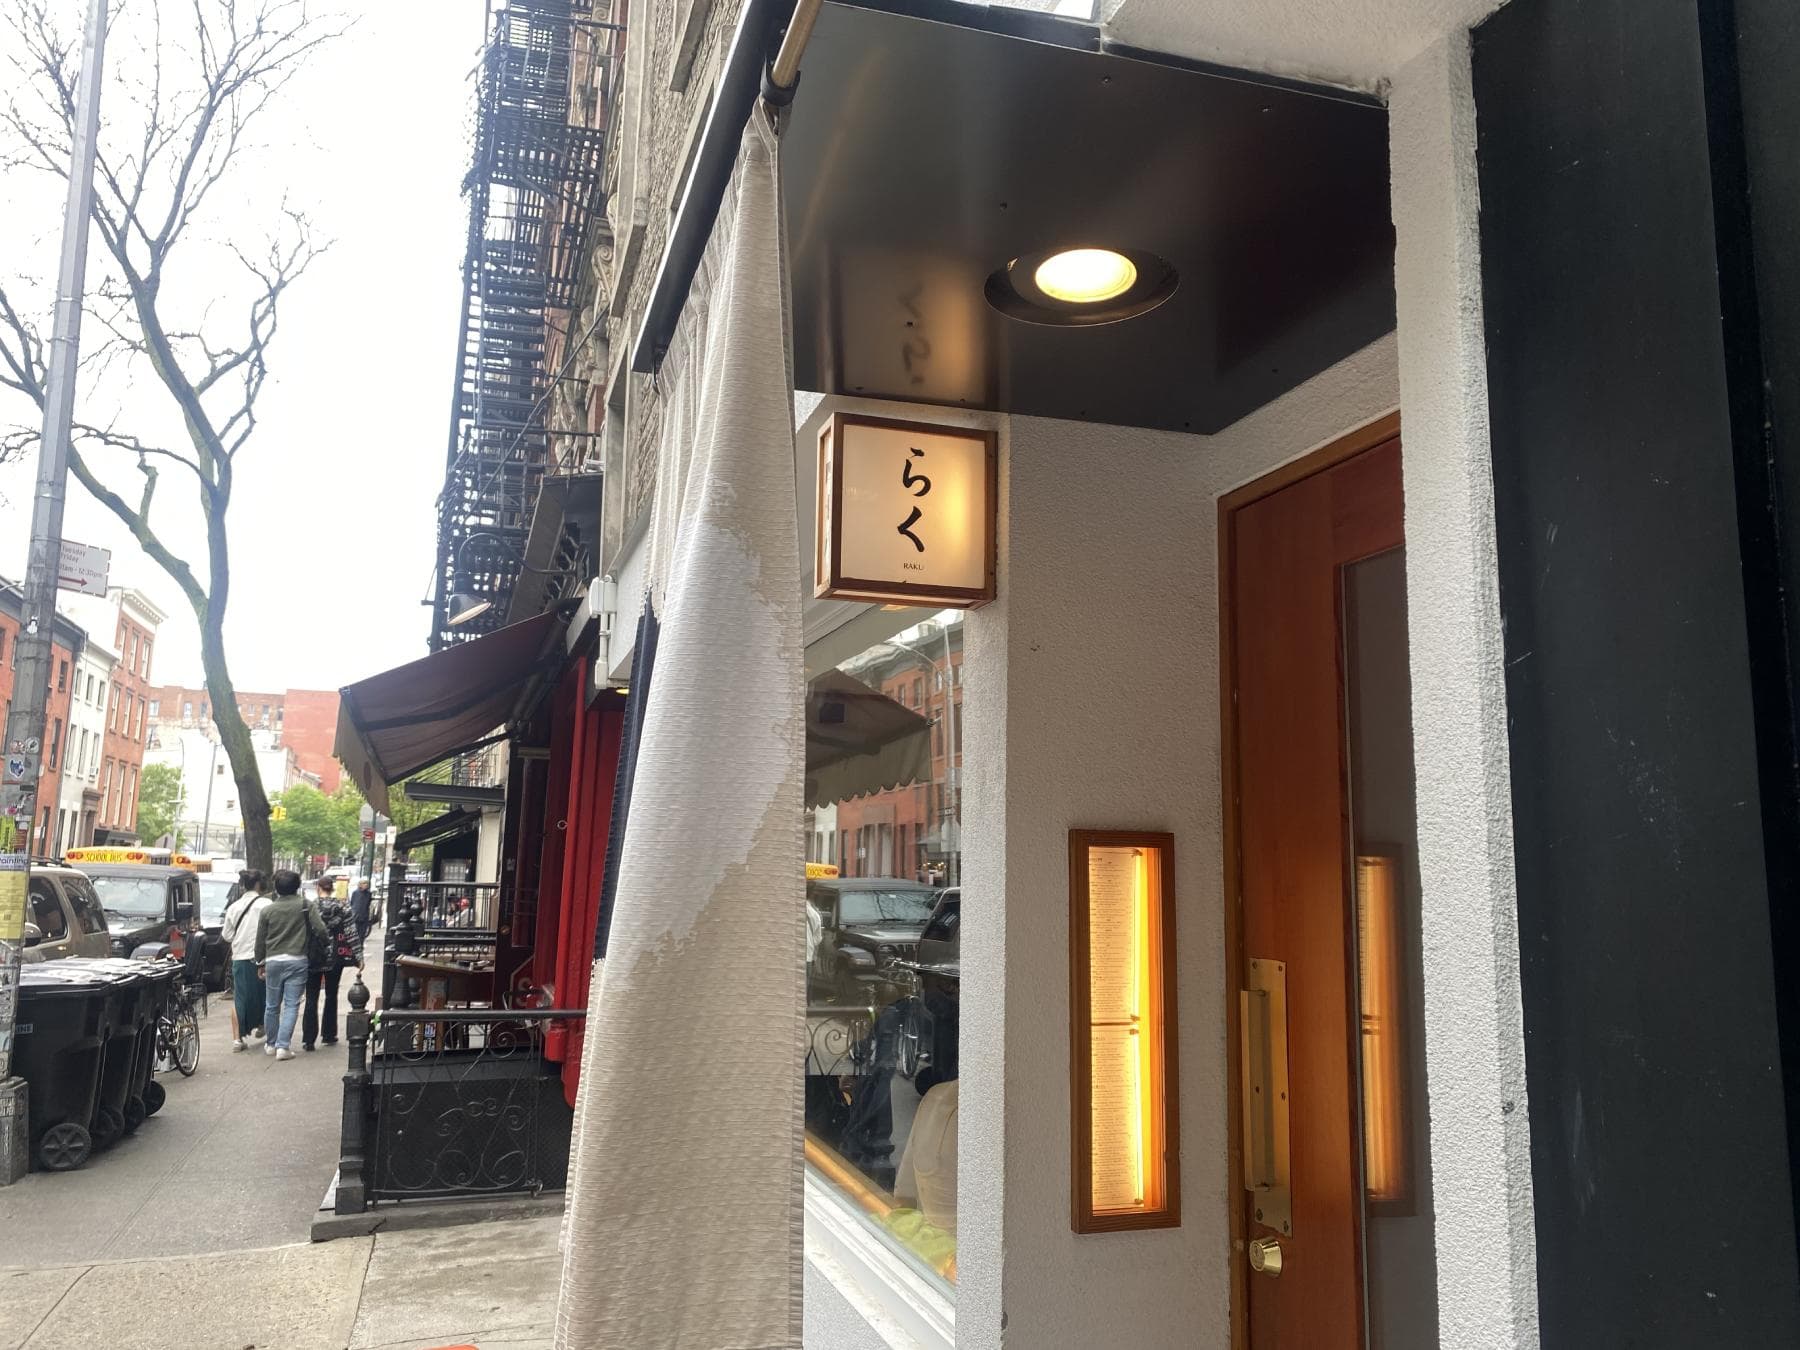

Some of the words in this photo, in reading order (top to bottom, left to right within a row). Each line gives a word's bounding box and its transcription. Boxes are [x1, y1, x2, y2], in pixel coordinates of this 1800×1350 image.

[897, 447, 932, 553] らく
[903, 562, 925, 571] RAKU
[86, 852, 108, 862] SCHOOL
[109, 852, 122, 862] BUS
